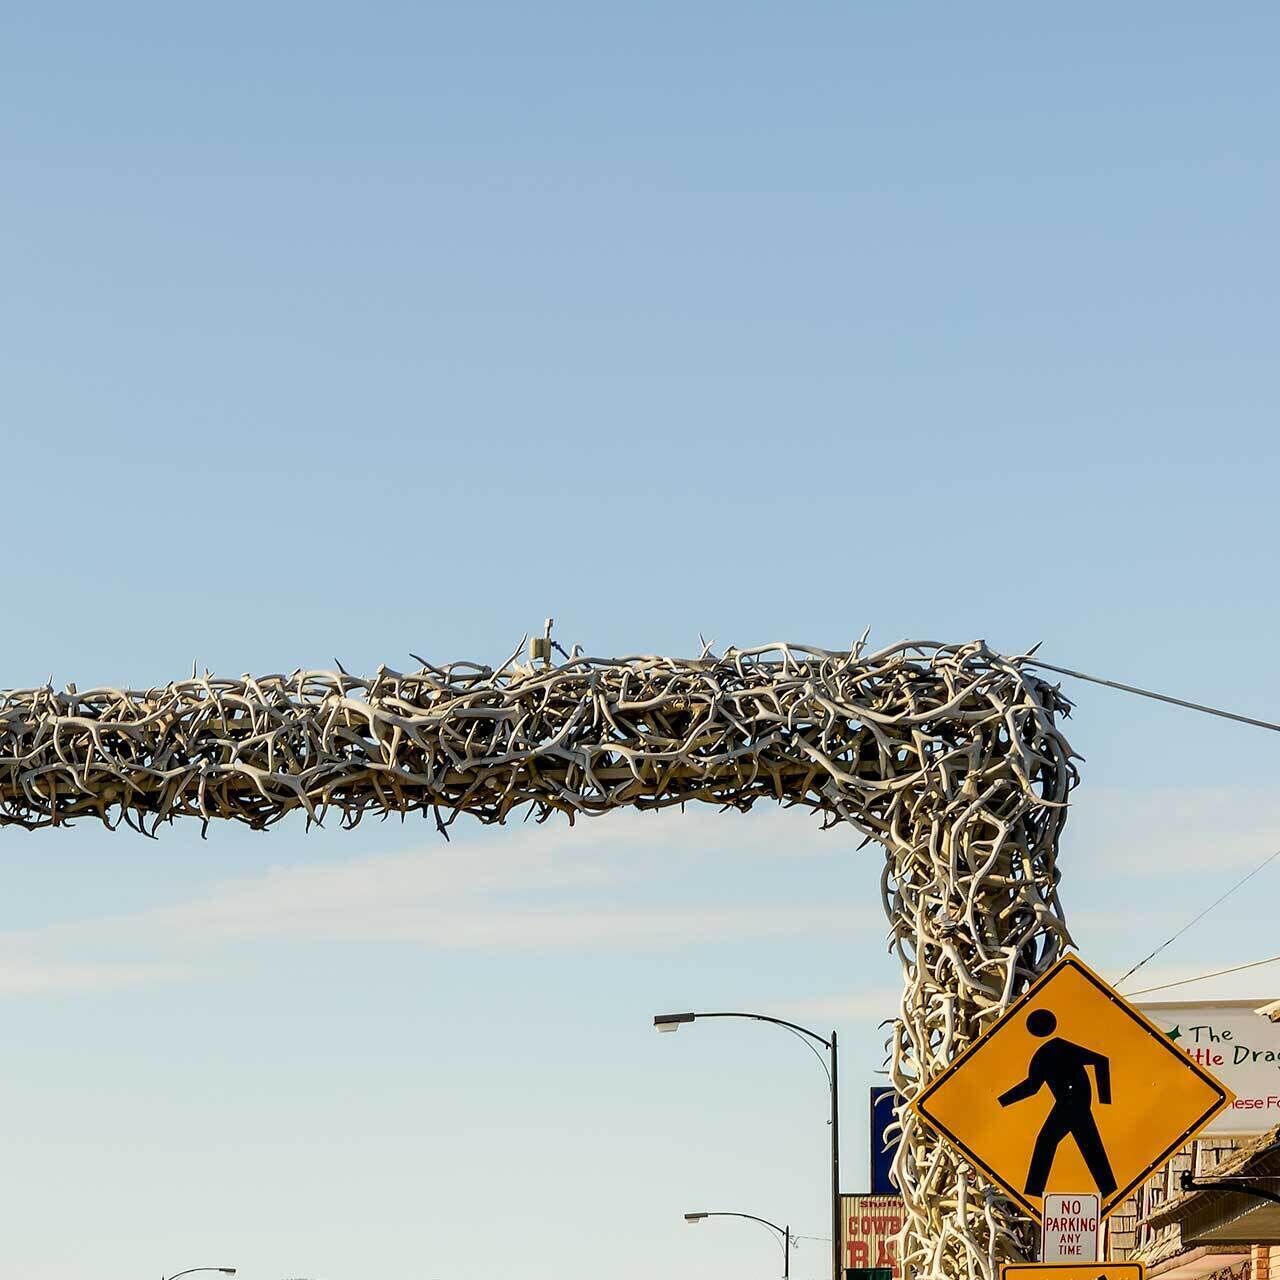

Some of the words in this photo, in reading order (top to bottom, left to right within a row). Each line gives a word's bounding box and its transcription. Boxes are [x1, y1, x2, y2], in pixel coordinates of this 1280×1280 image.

[1189, 1025, 1234, 1043] The
[1186, 1048, 1224, 1066] tle
[1061, 1200, 1082, 1215] NO
[1046, 1217, 1096, 1233] PARKING
[1059, 1233, 1081, 1244] ANY
[1058, 1245, 1083, 1256] TIME
